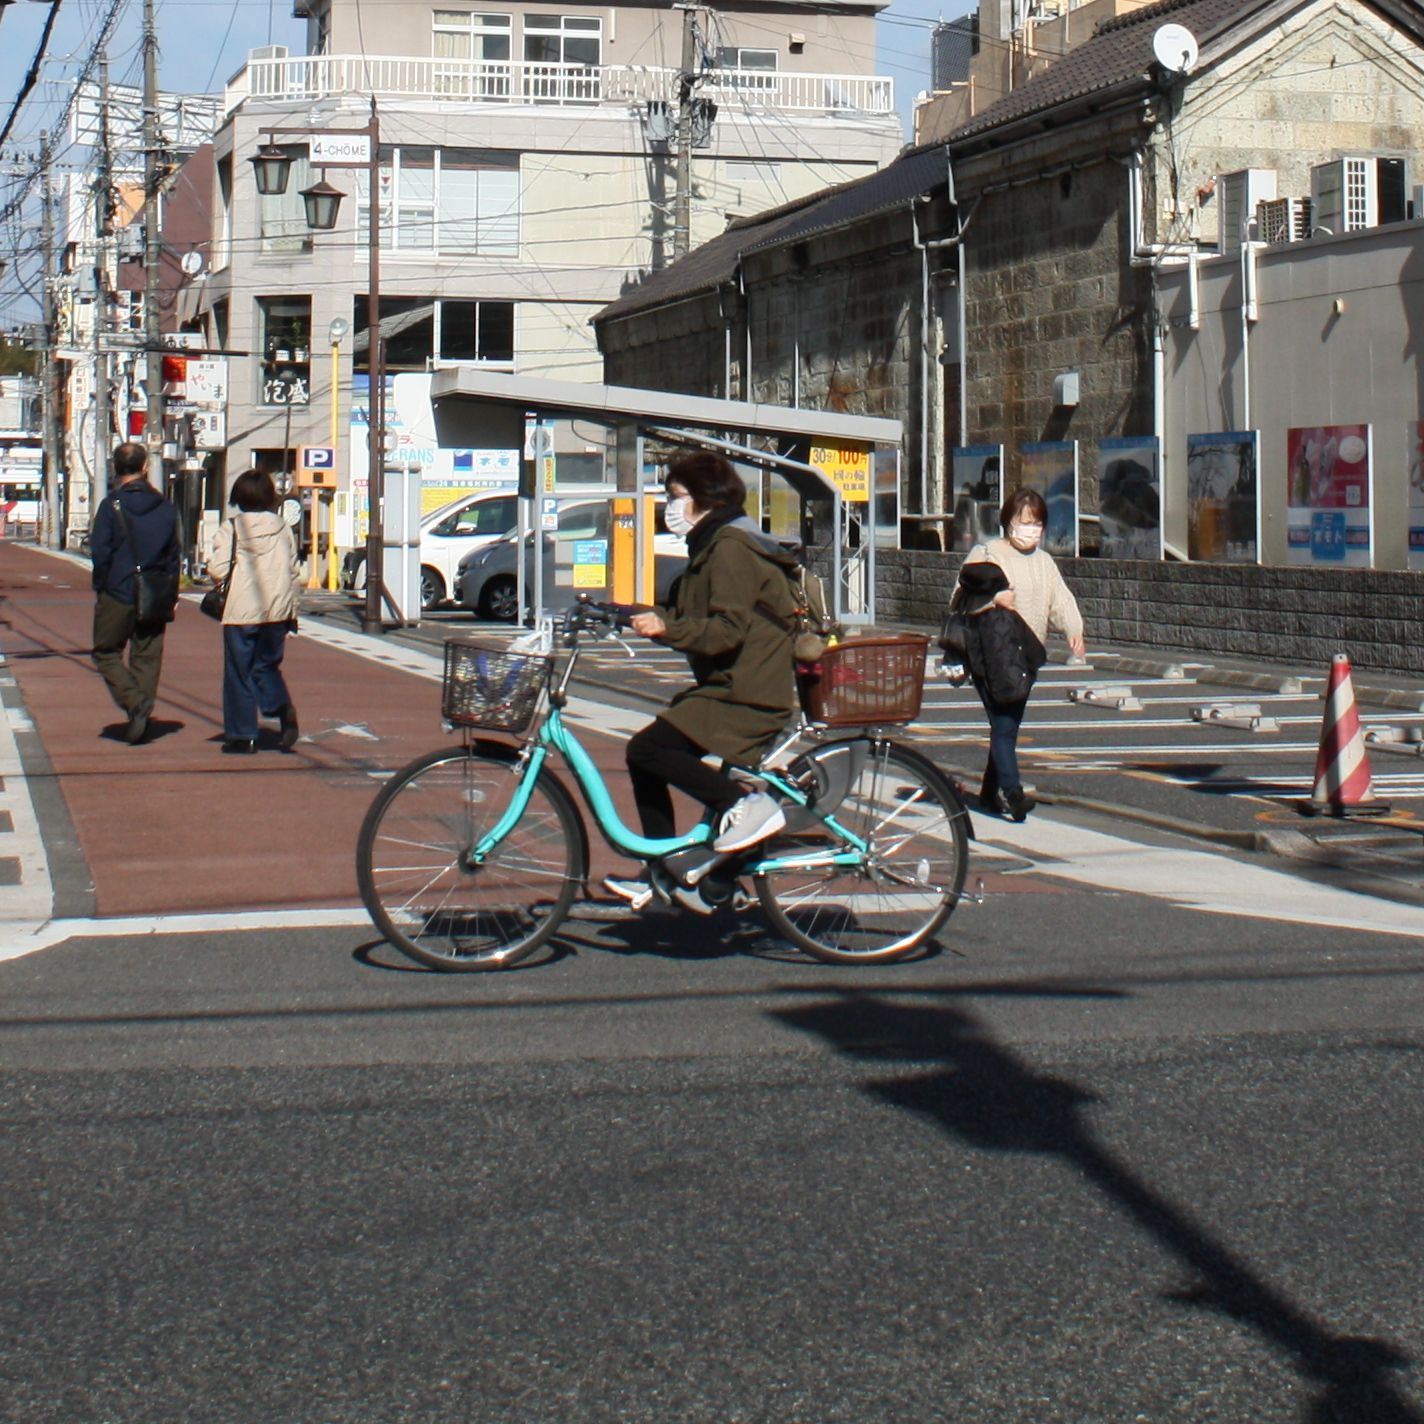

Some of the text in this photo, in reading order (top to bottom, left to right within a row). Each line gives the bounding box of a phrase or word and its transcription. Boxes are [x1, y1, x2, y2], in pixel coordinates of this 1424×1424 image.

[313, 142, 367, 156] 4-CHŌME
[263, 378, 309, 404] 泡盛
[309, 448, 329, 466] P
[544, 499, 556, 513] P
